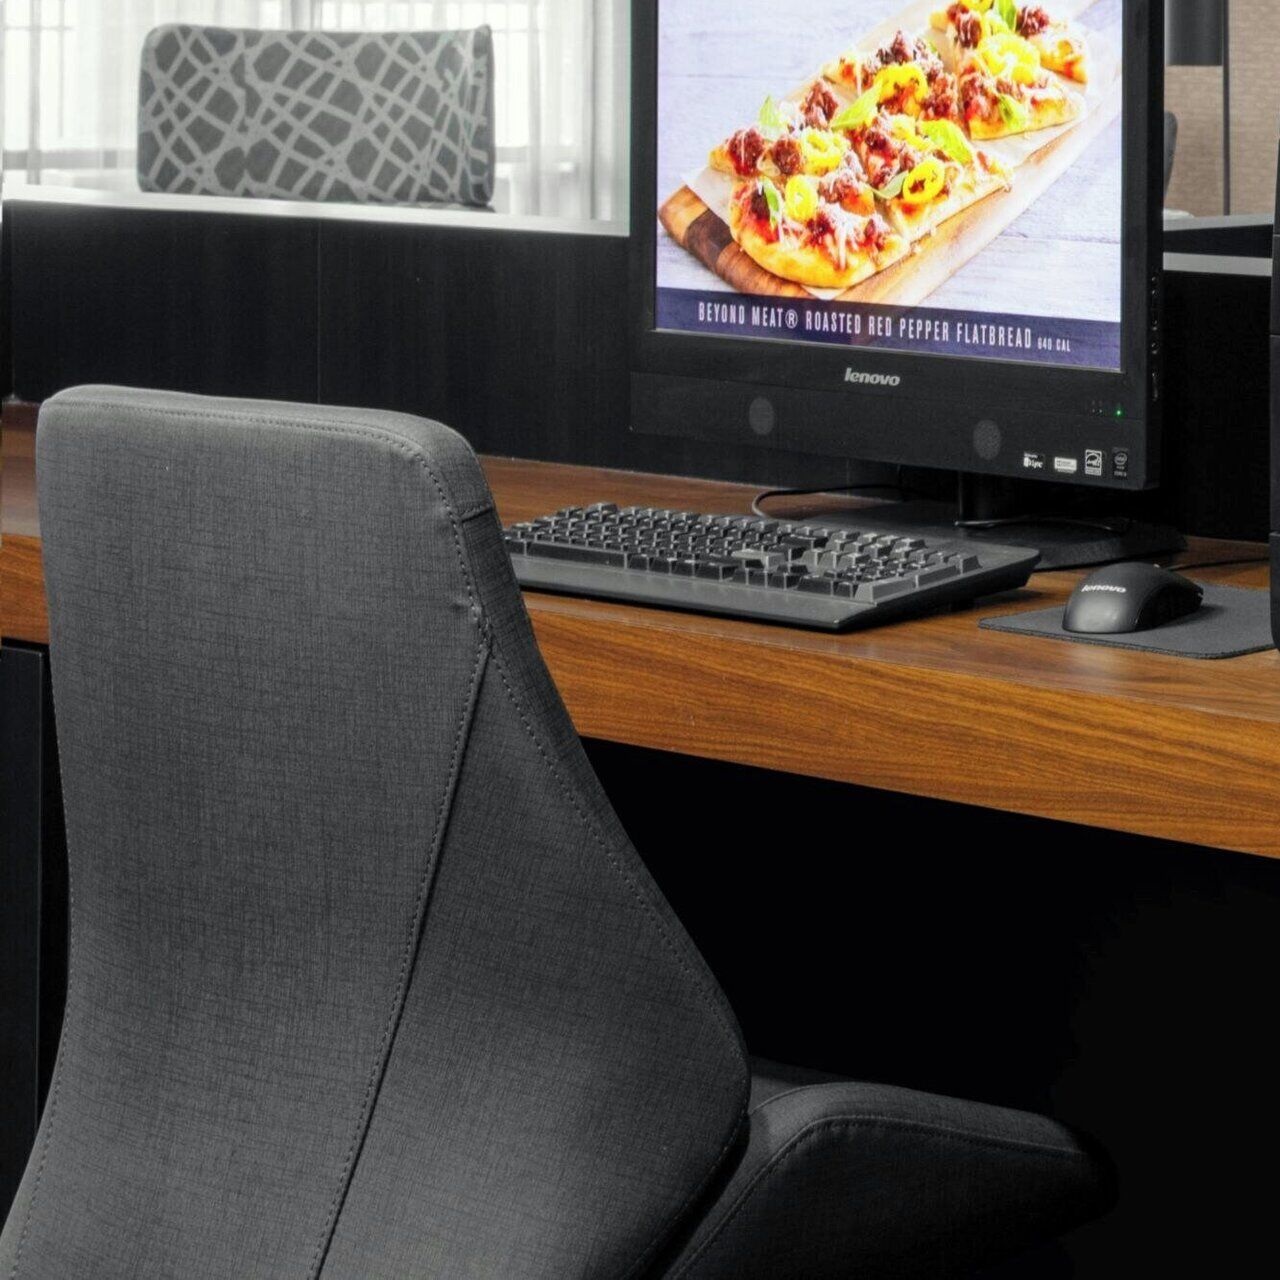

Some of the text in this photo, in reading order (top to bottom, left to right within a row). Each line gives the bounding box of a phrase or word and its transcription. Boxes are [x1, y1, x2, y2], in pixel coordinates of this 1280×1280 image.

[698, 301, 745, 325] BEYOND
[805, 310, 861, 335] ROASTED
[868, 315, 893, 337] RED
[899, 317, 949, 342] PEPPER
[956, 322, 1032, 349] FLATBREAD
[1056, 338, 1071, 352] CAL
[844, 367, 901, 387] lenovo
